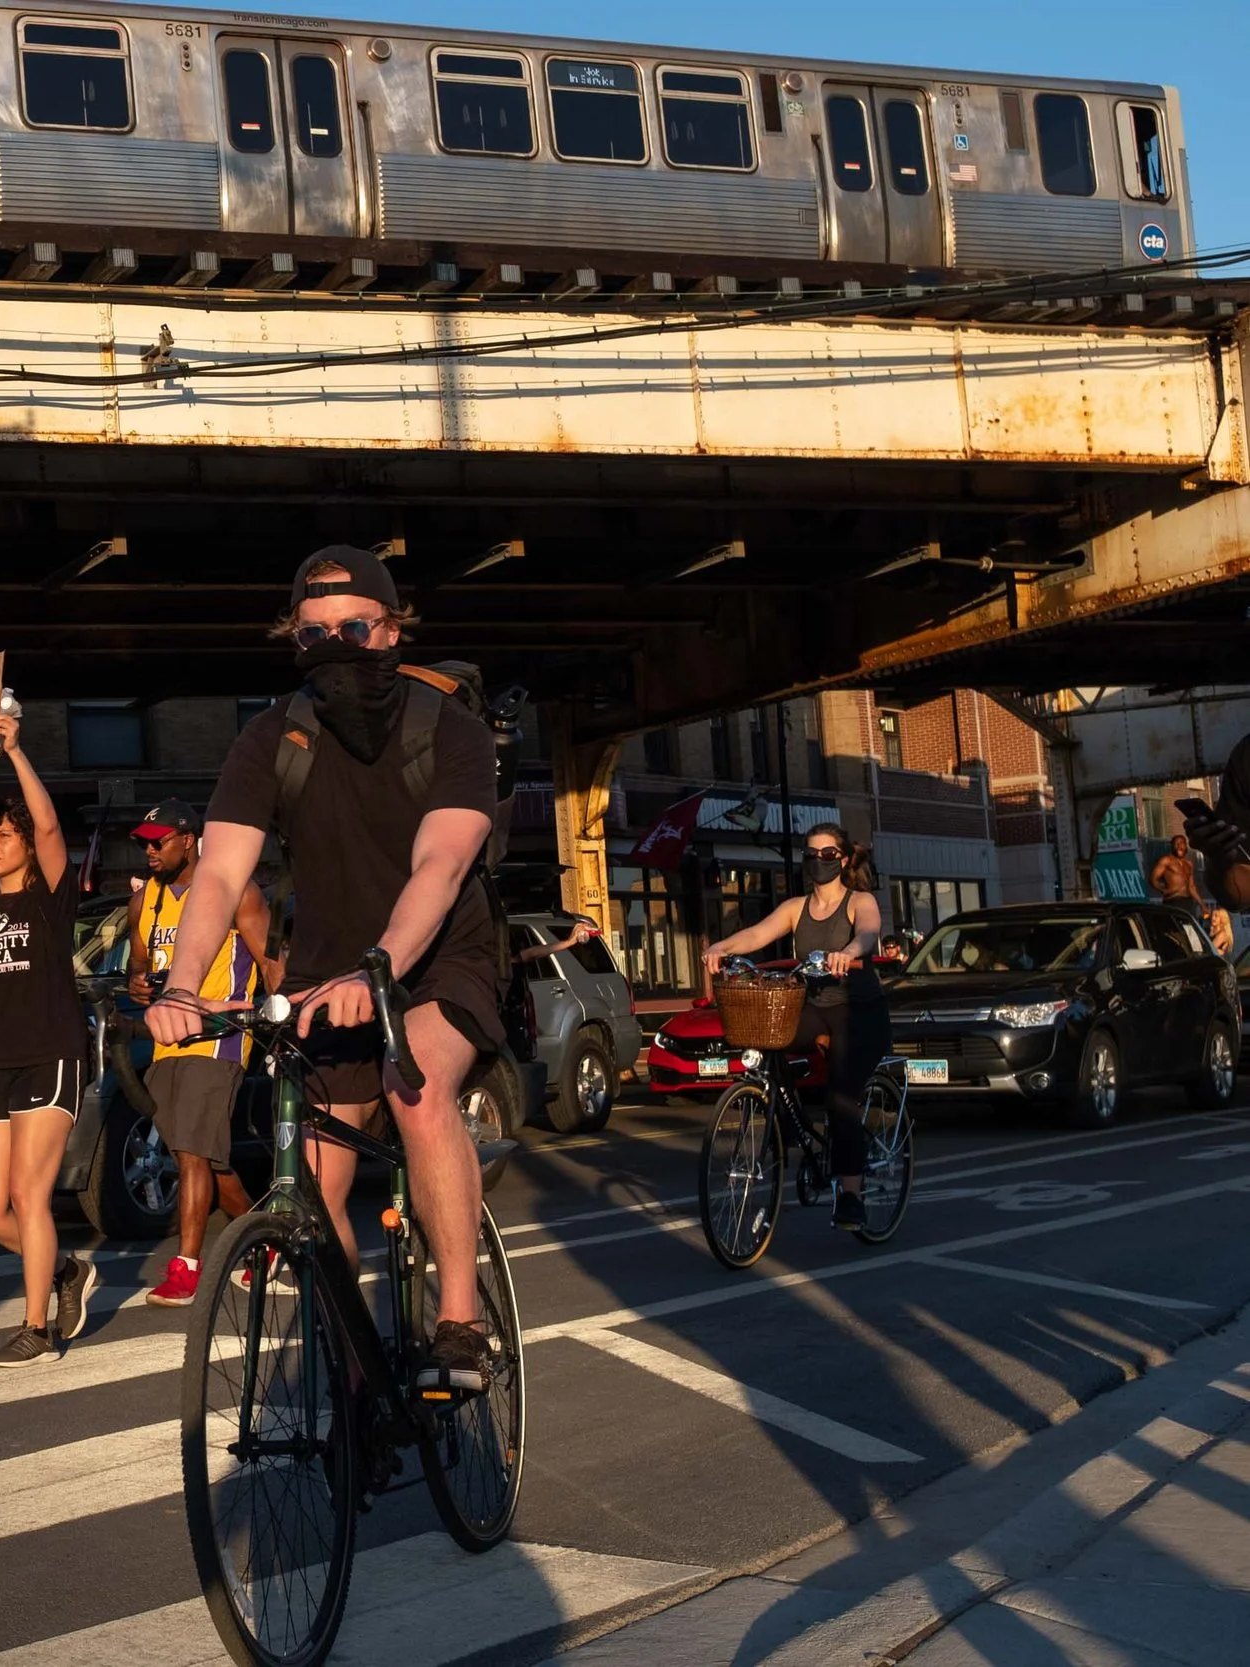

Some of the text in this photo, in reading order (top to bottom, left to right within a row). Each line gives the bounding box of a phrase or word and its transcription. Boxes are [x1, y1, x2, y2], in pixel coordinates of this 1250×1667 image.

[234, 13, 329, 28] transitchicago.com
[165, 23, 202, 39] 5681
[941, 84, 970, 97] 5681
[1143, 234, 1164, 248] cta
[587, 889, 599, 899] 60
[7, 922, 29, 931] 2014
[147, 925, 178, 949] LAK
